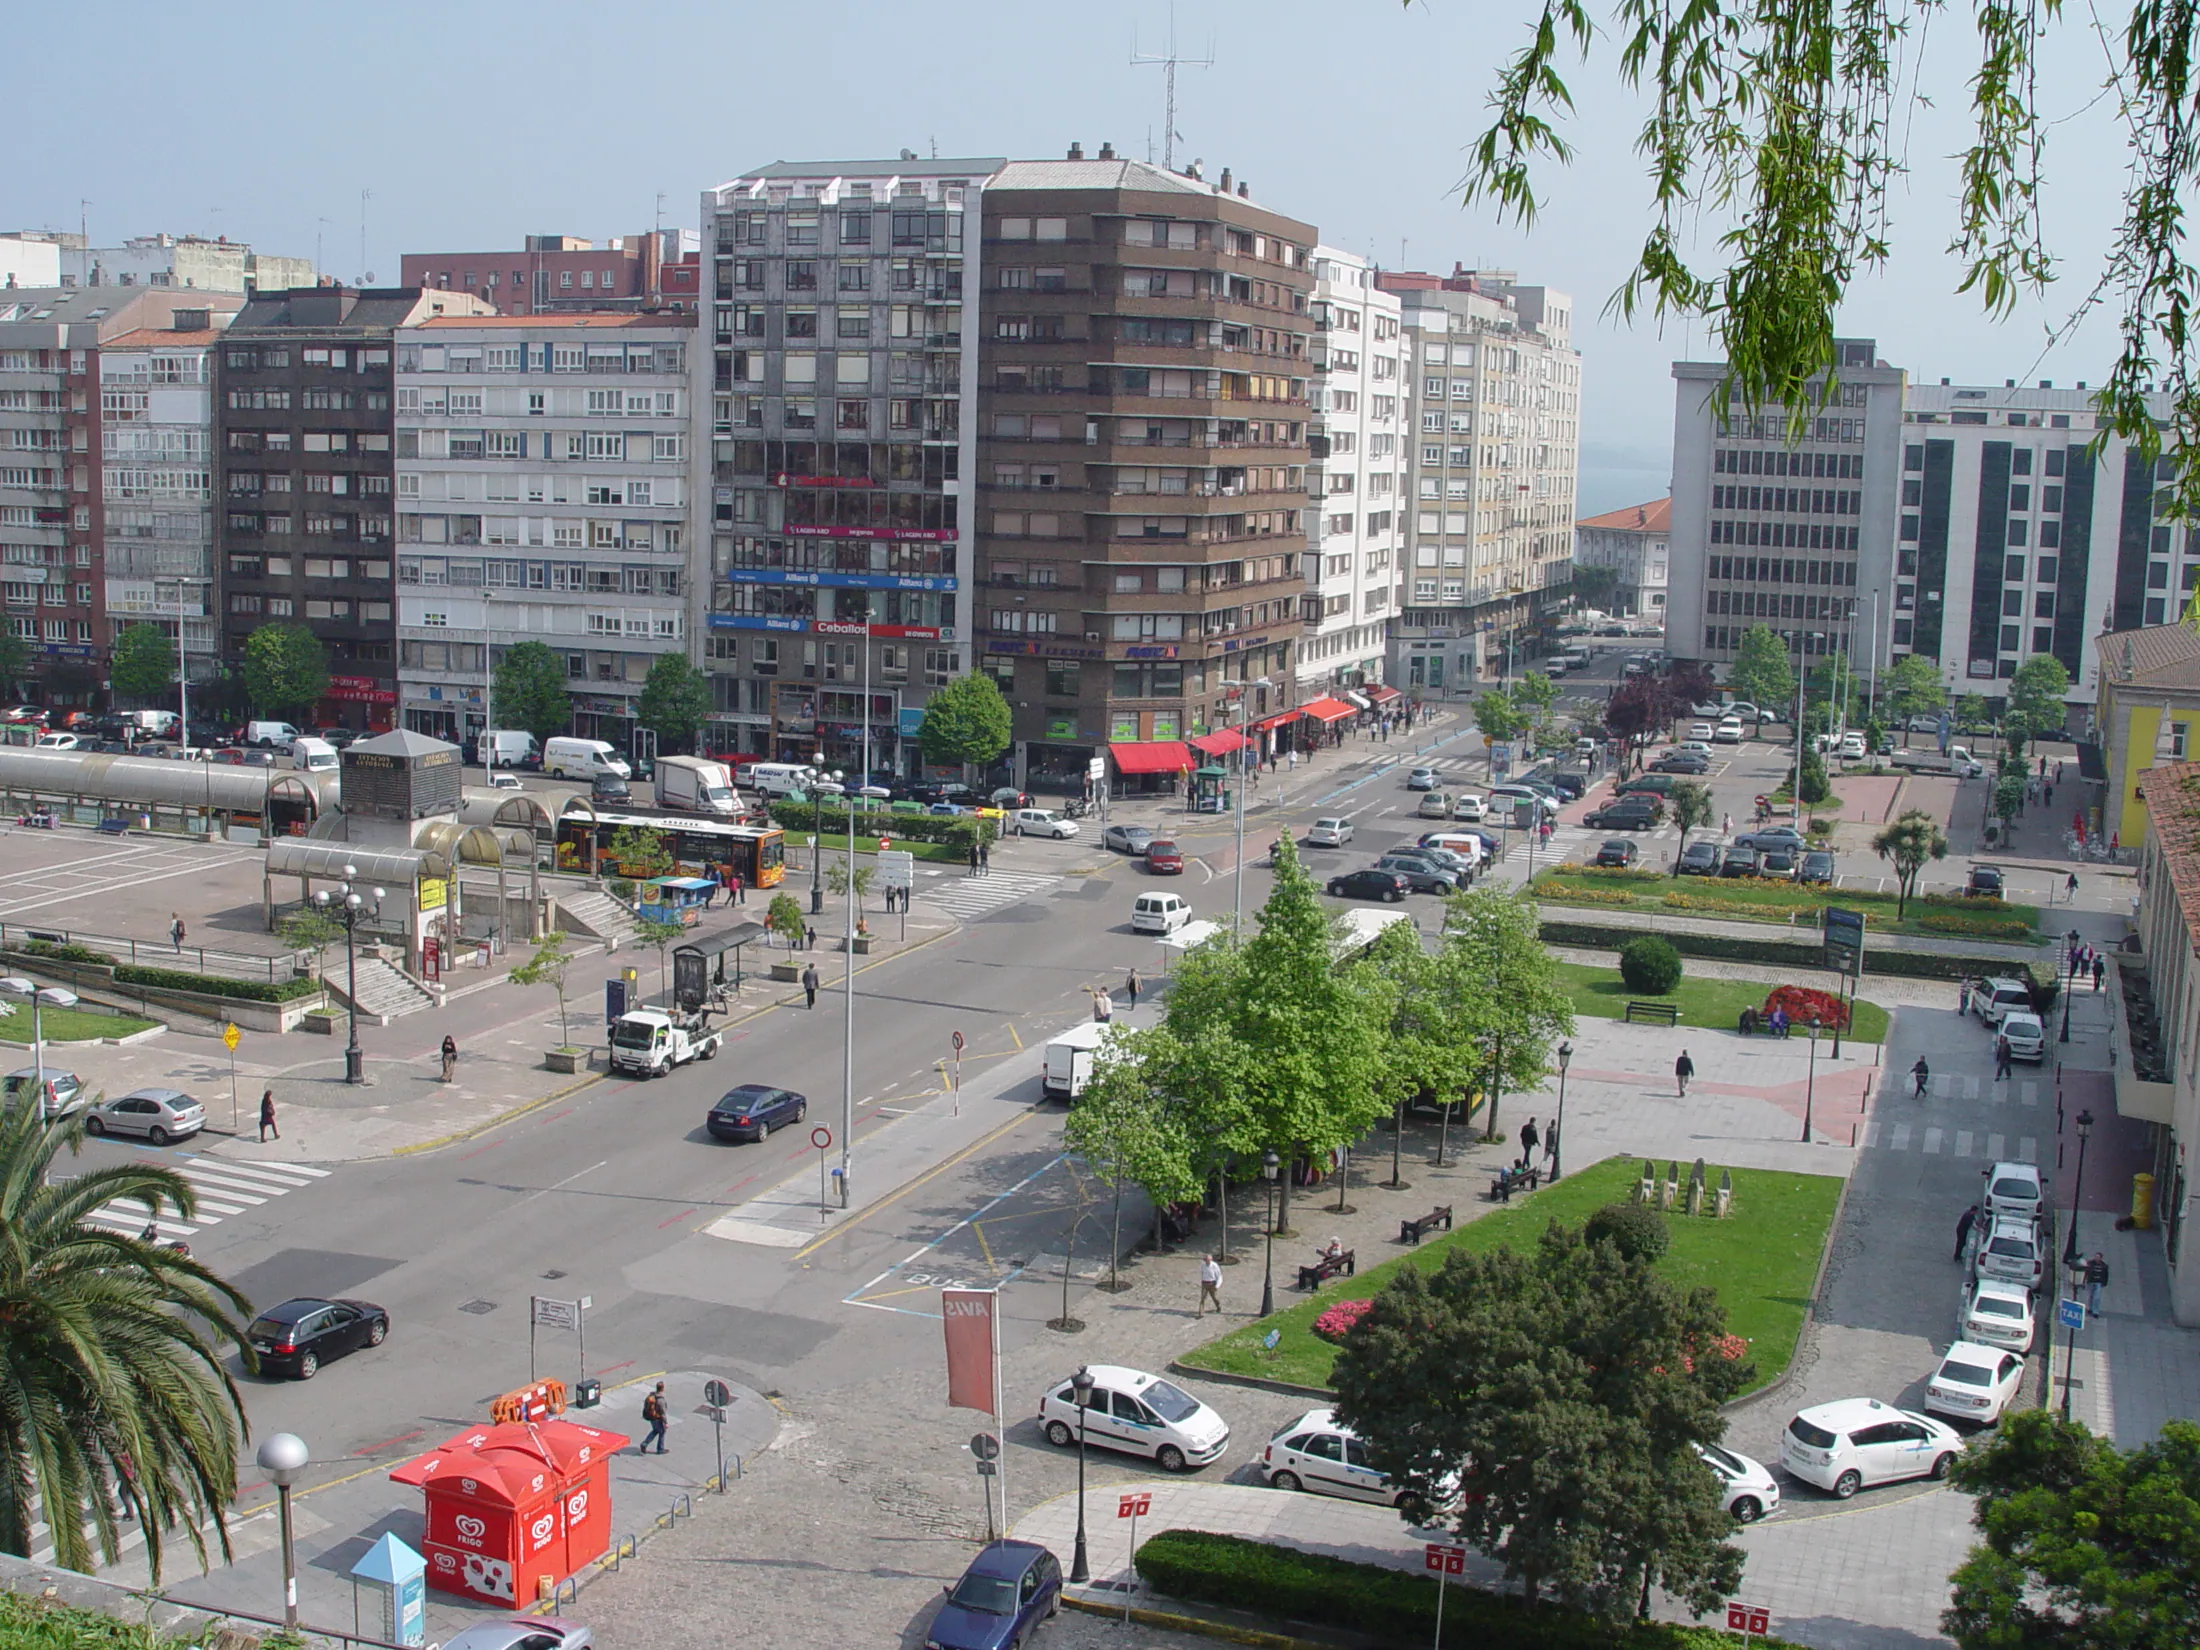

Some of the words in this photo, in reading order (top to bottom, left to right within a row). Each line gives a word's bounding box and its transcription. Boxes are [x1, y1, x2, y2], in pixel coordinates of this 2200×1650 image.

[785, 573, 809, 583] Allianz
[899, 578, 924, 588] Allianz
[766, 619, 790, 629] Allianz
[817, 622, 867, 635] Ceballos
[906, 1273, 973, 1289] BUS
[2060, 1308, 2082, 1321] TAXI
[457, 1534, 483, 1547] FRIGO
[533, 1534, 552, 1551] FRIGO
